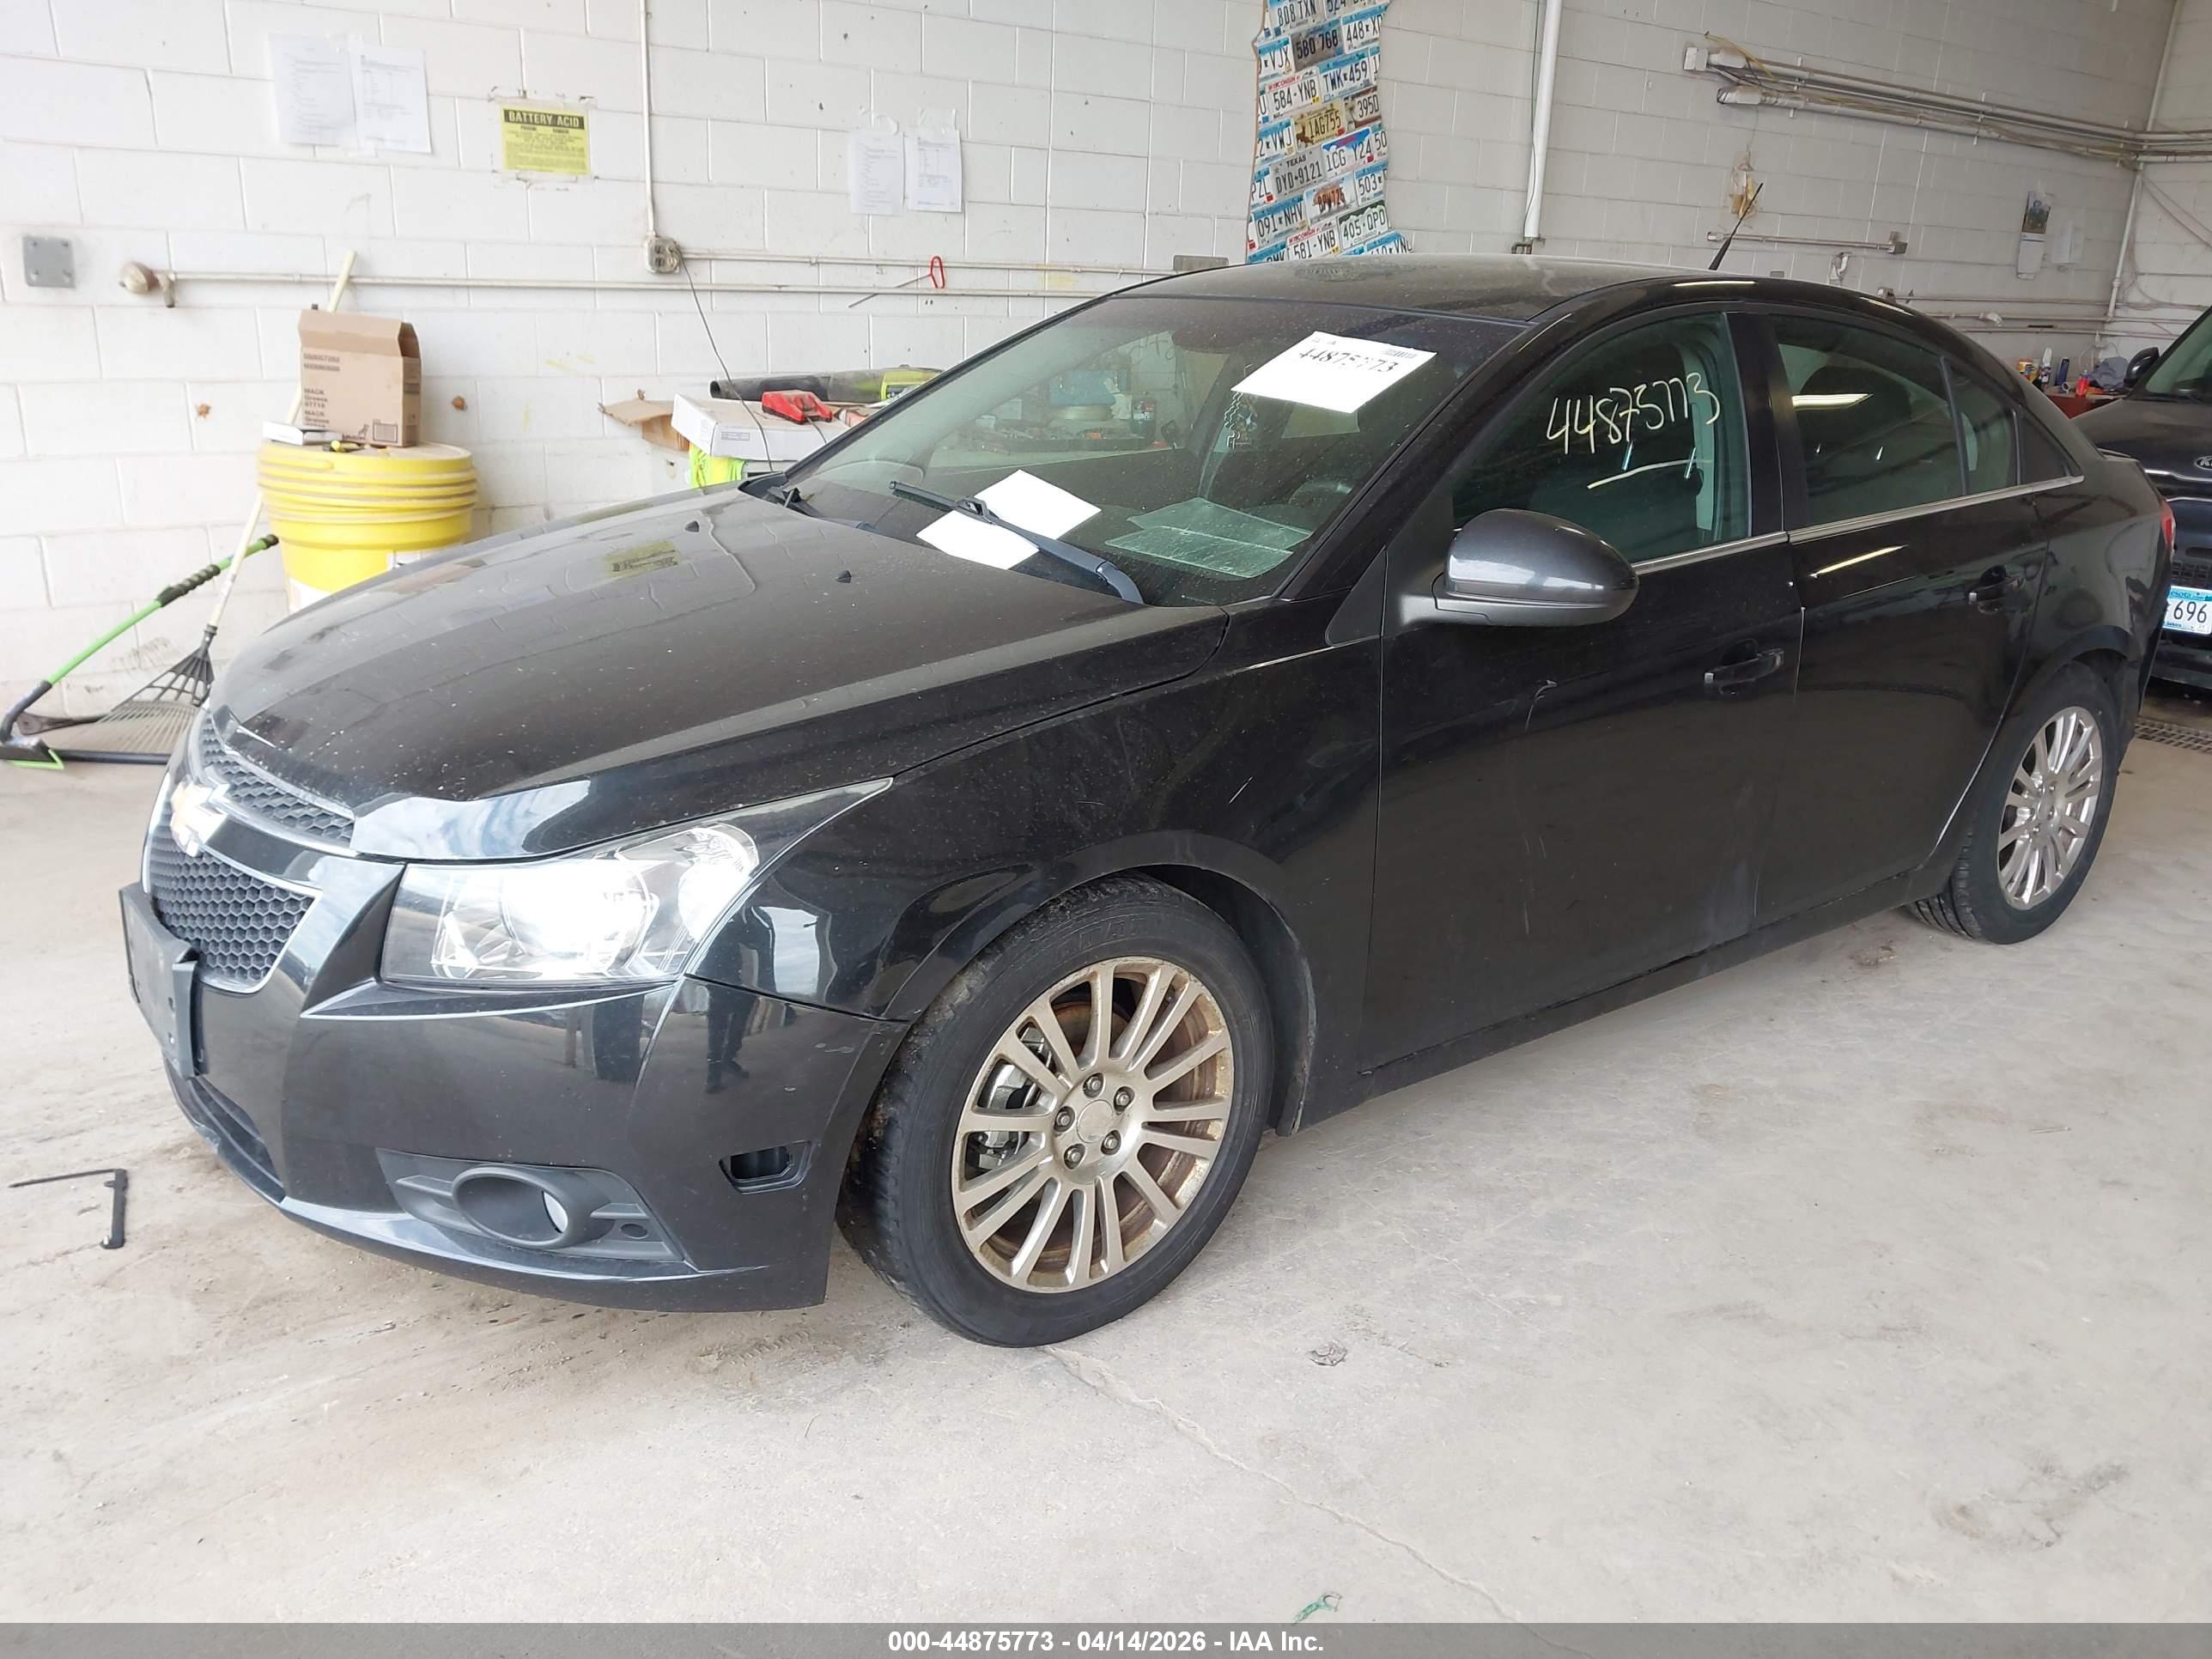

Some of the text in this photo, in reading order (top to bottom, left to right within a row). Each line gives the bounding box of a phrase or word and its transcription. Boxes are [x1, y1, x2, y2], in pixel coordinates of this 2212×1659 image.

[1278, 3, 1296, 27] 808
[1346, 20, 1364, 42] 448
[1269, 46, 1290, 70] VJX
[1323, 68, 1344, 93] TWK
[1348, 60, 1368, 83] 459
[508, 111, 580, 128] BATTERY ACID
[1271, 127, 1292, 152] VWJ
[1285, 155, 1307, 168] TEXAS
[1298, 161, 1322, 185] 9121
[1358, 173, 1377, 197] 503
[1257, 214, 1278, 238] 091
[1284, 202, 1303, 228] NHV
[1547, 372, 1721, 454] 44875773
[2173, 599, 2207, 623] 696
